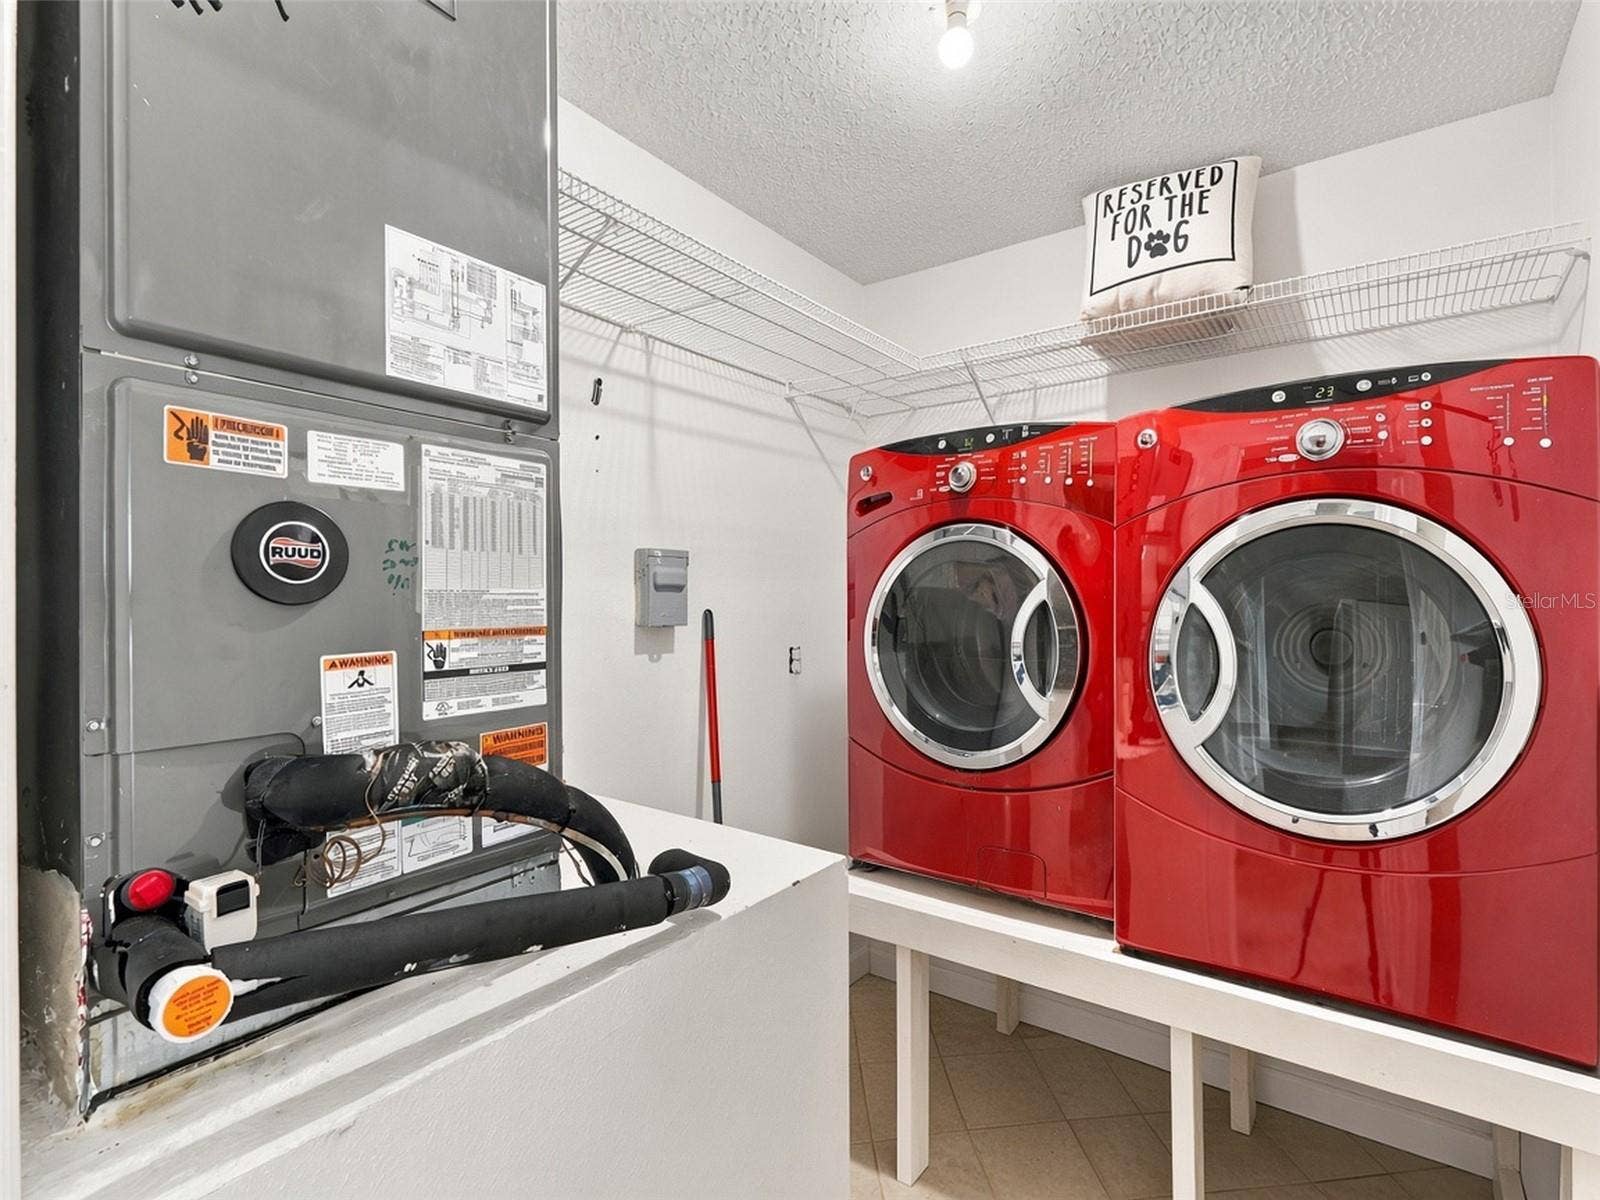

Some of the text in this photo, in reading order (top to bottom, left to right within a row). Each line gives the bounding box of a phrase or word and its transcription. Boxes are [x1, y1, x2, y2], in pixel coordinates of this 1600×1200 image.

[1103, 166, 1224, 218] RESERVED
[1111, 189, 1211, 241] FOR THE
[1315, 386, 1335, 399] 23
[271, 546, 322, 559] RUUD
[339, 655, 389, 669] WARNING
